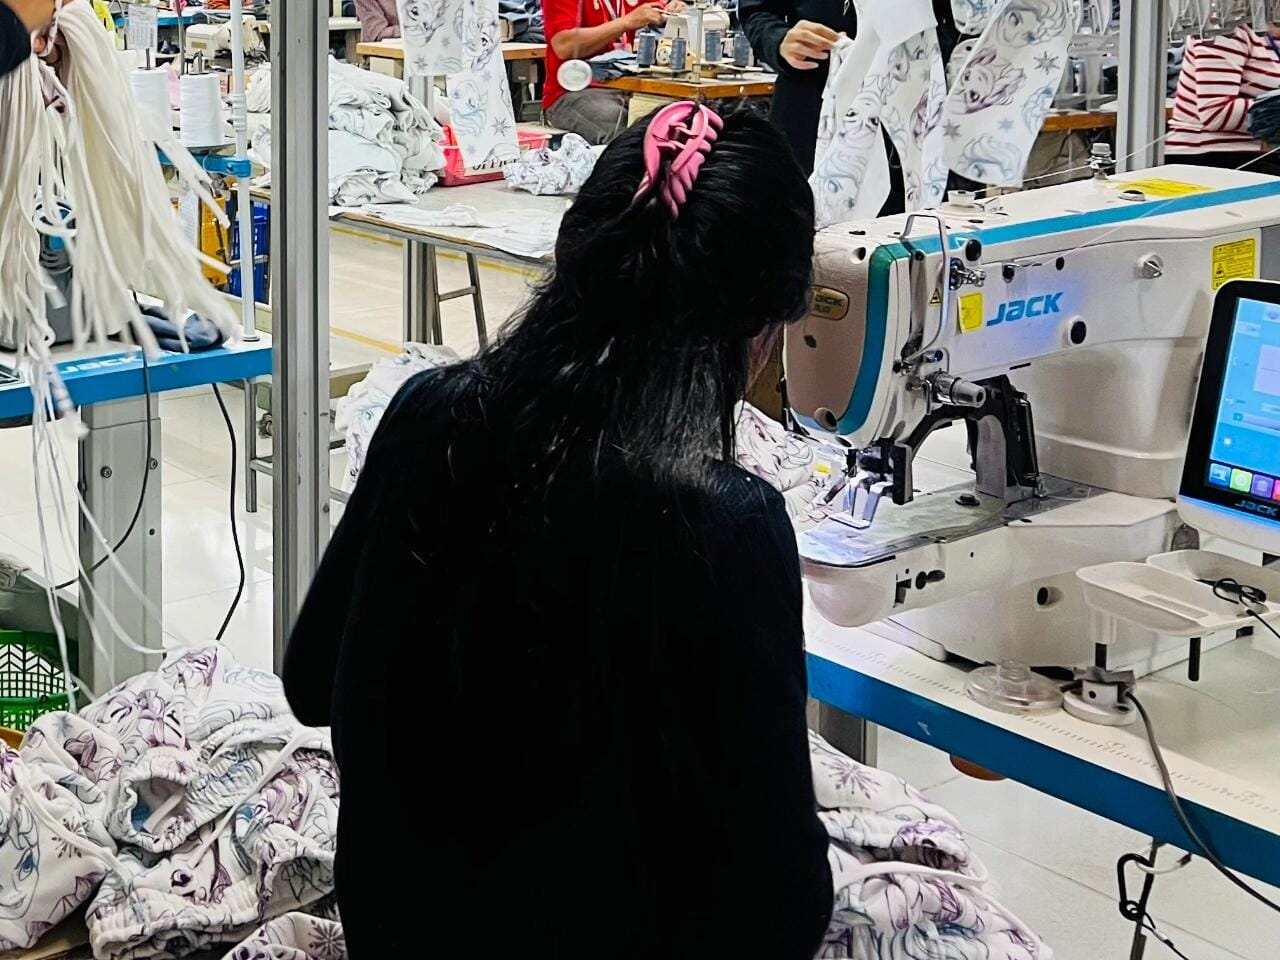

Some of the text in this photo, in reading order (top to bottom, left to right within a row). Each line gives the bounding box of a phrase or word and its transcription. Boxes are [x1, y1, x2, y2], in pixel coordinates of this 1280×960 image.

[815, 295, 843, 307] ACK
[986, 291, 1064, 327] JACK
[1235, 499, 1278, 517] JACK
